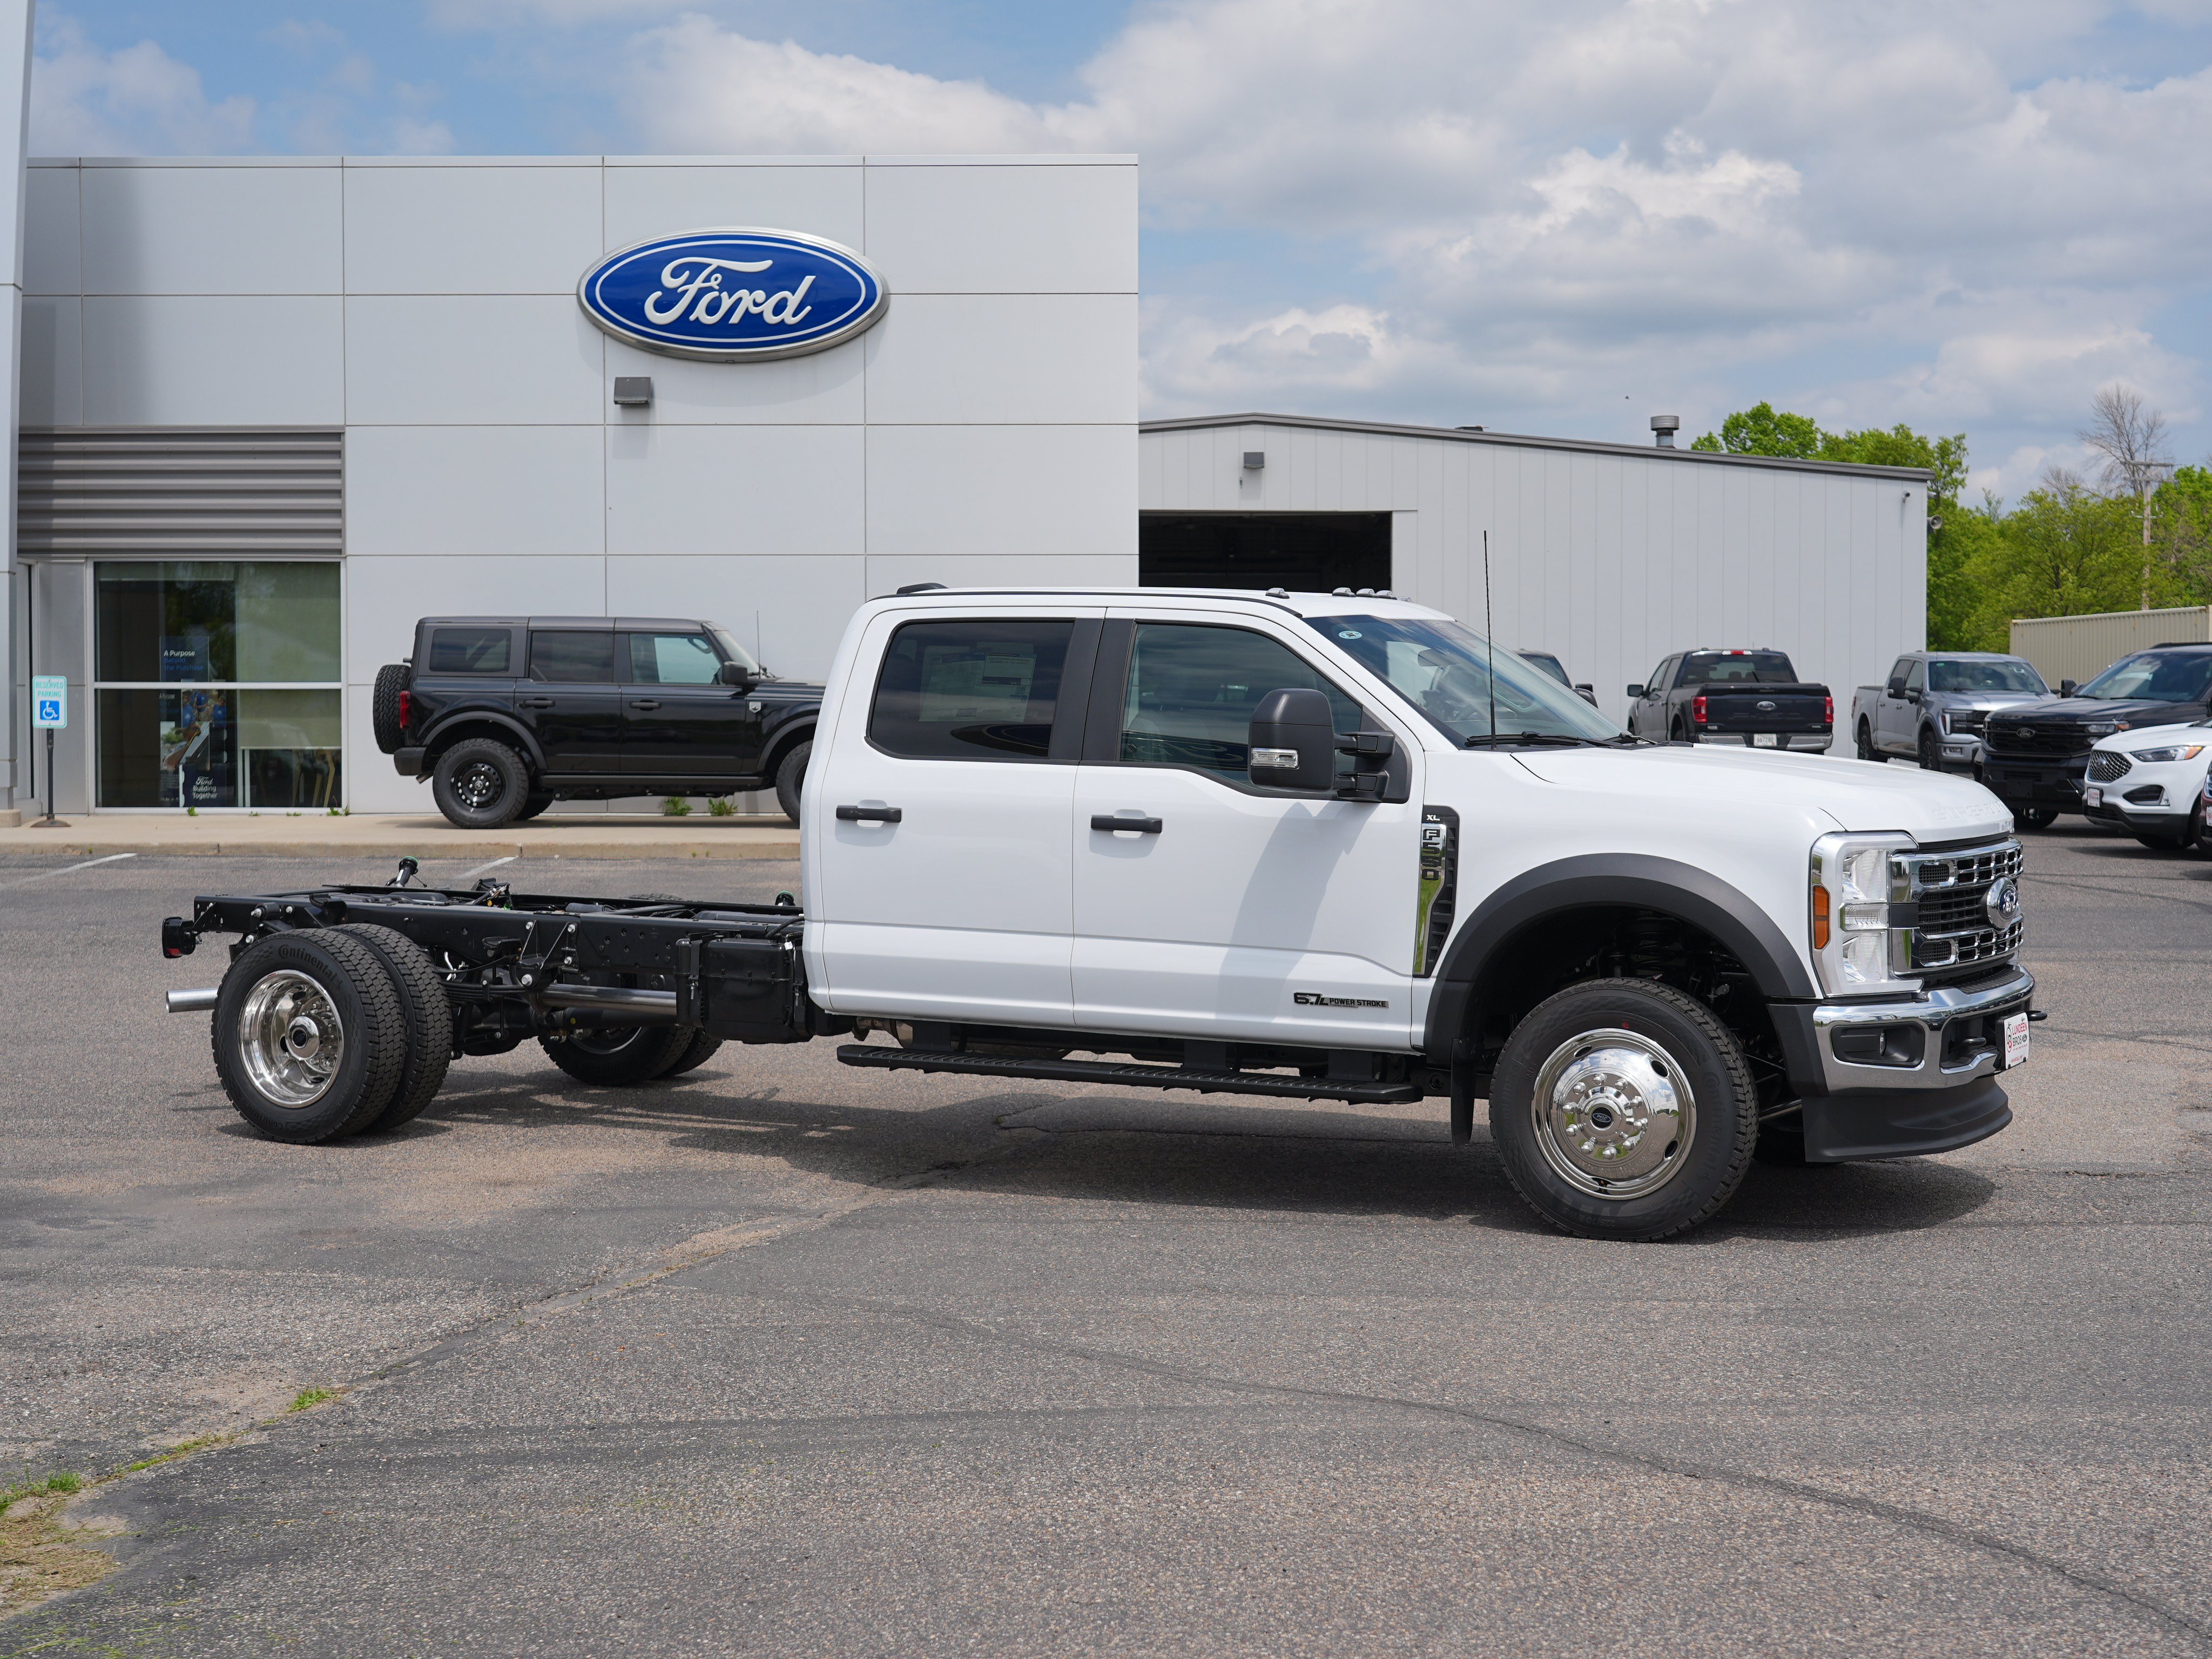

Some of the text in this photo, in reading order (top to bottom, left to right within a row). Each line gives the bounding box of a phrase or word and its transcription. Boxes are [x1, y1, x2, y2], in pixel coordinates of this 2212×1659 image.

[644, 257, 816, 325] Ford
[195, 776, 213, 785] Ford
[278, 944, 338, 982] Continental
[1293, 993, 1329, 1006] 6.7L
[2012, 1022, 2028, 1035] LUNDEEN
[2013, 1035, 2022, 1047] BROS
